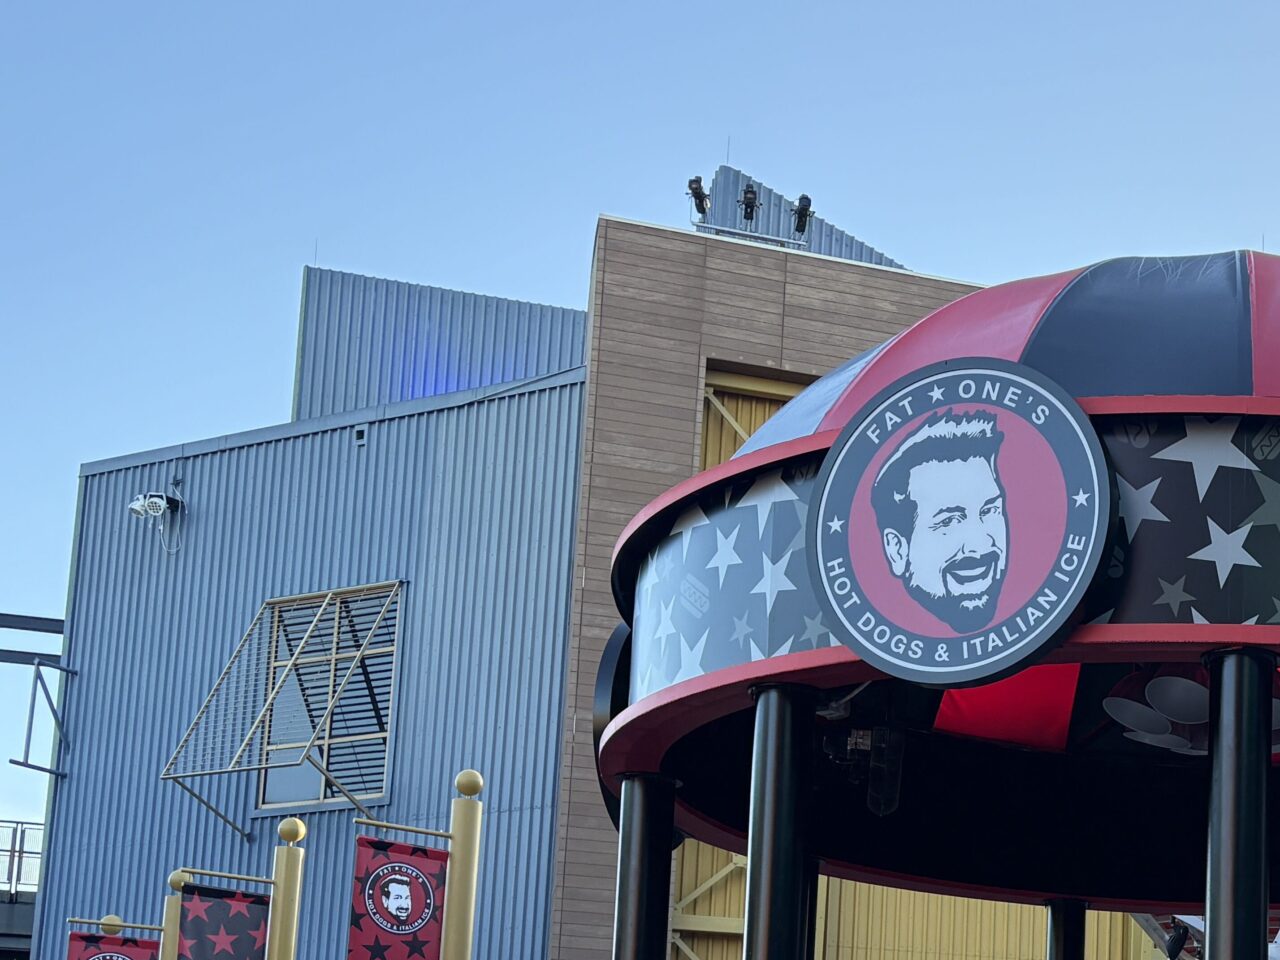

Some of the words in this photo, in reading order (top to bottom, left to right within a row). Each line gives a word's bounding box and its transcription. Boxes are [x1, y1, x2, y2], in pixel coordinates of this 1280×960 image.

[866, 397, 914, 444] FAT
[958, 379, 1050, 425] ONE'S
[827, 557, 861, 610] HOT
[856, 611, 925, 659] DOGS
[934, 644, 950, 662] &
[962, 589, 1059, 660] ITALIAN
[1054, 534, 1087, 583] ICE
[379, 867, 392, 876] FAT
[368, 899, 377, 912] HOT
[375, 913, 392, 928] DOGS
[399, 919, 424, 931] ITALIAN
[422, 908, 430, 919] ICE
